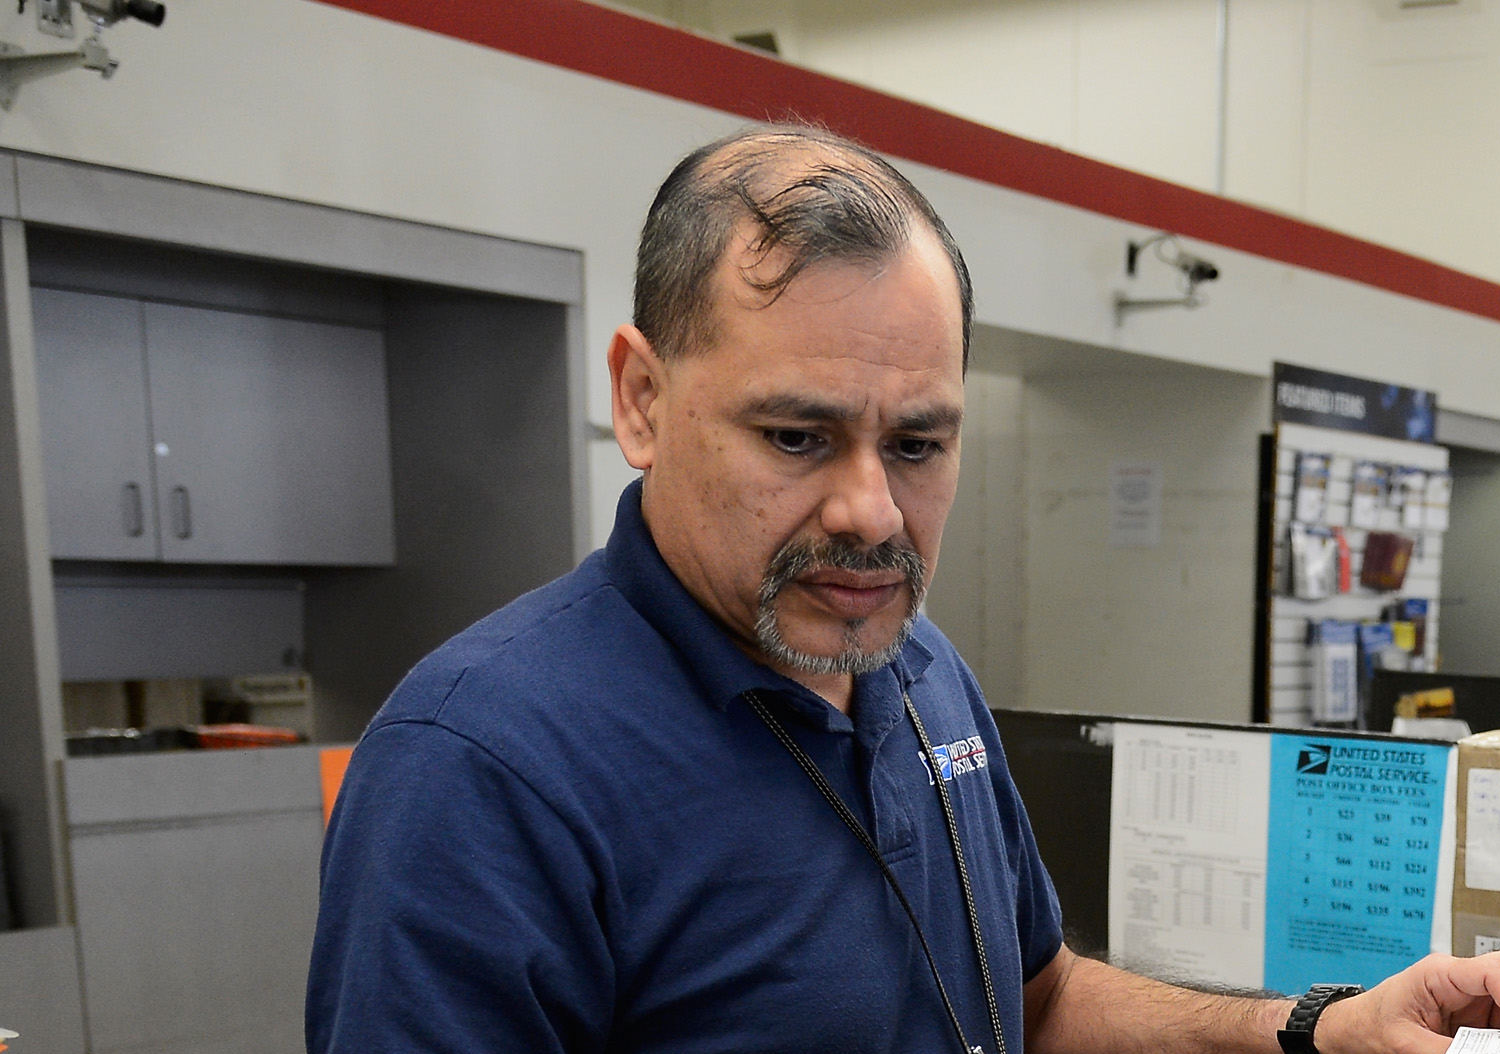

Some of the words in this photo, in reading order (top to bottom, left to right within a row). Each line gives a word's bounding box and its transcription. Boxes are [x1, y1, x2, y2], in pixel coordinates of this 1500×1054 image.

[1333, 747, 1380, 762] UNITED
[1383, 750, 1425, 766] STATES
[1331, 764, 1374, 780] POSTAL
[1378, 768, 1431, 784] SERVICE
